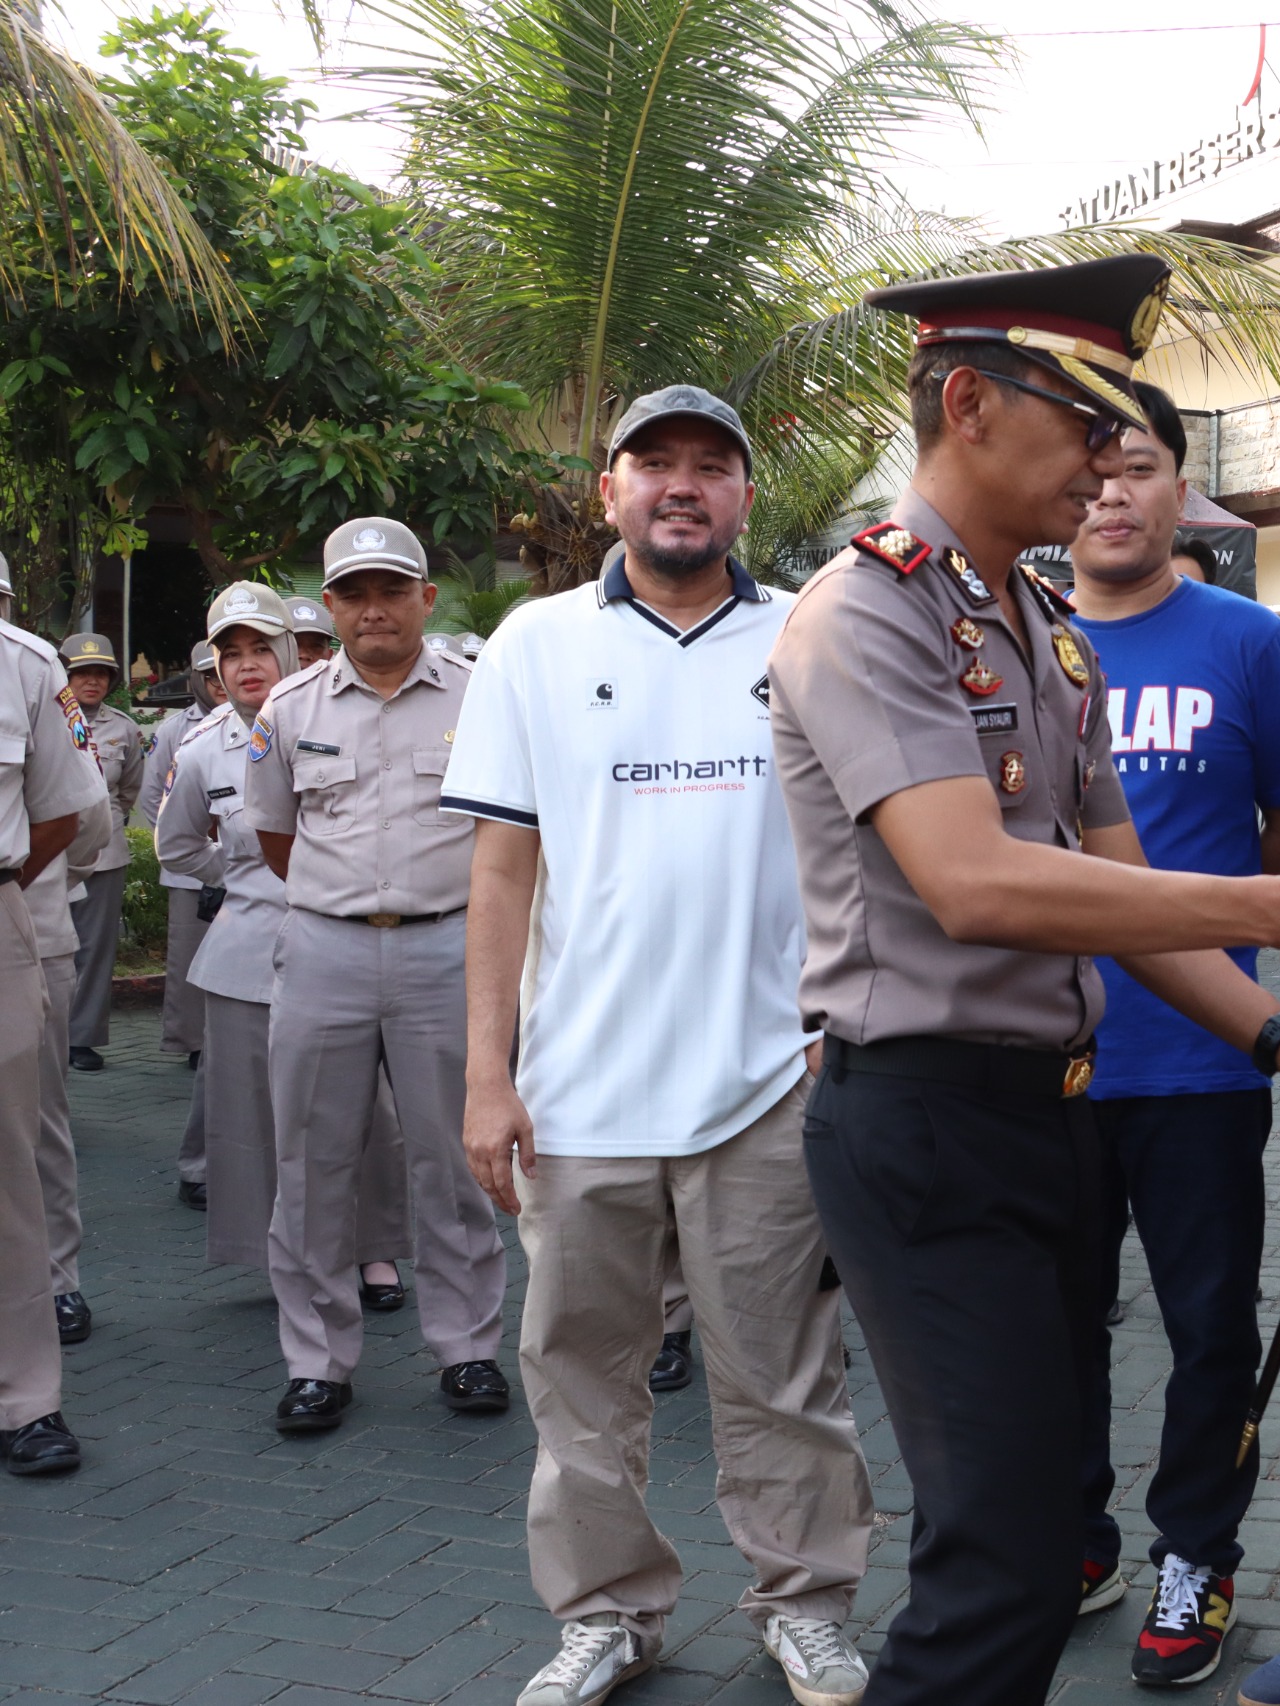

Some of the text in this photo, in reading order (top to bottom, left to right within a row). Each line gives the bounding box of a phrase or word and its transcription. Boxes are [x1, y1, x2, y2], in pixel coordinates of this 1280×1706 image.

[1106, 686, 1214, 754] LAP
[1118, 756, 1207, 773] AUTAS
[634, 783, 746, 796] WORK IN PROGRESS
